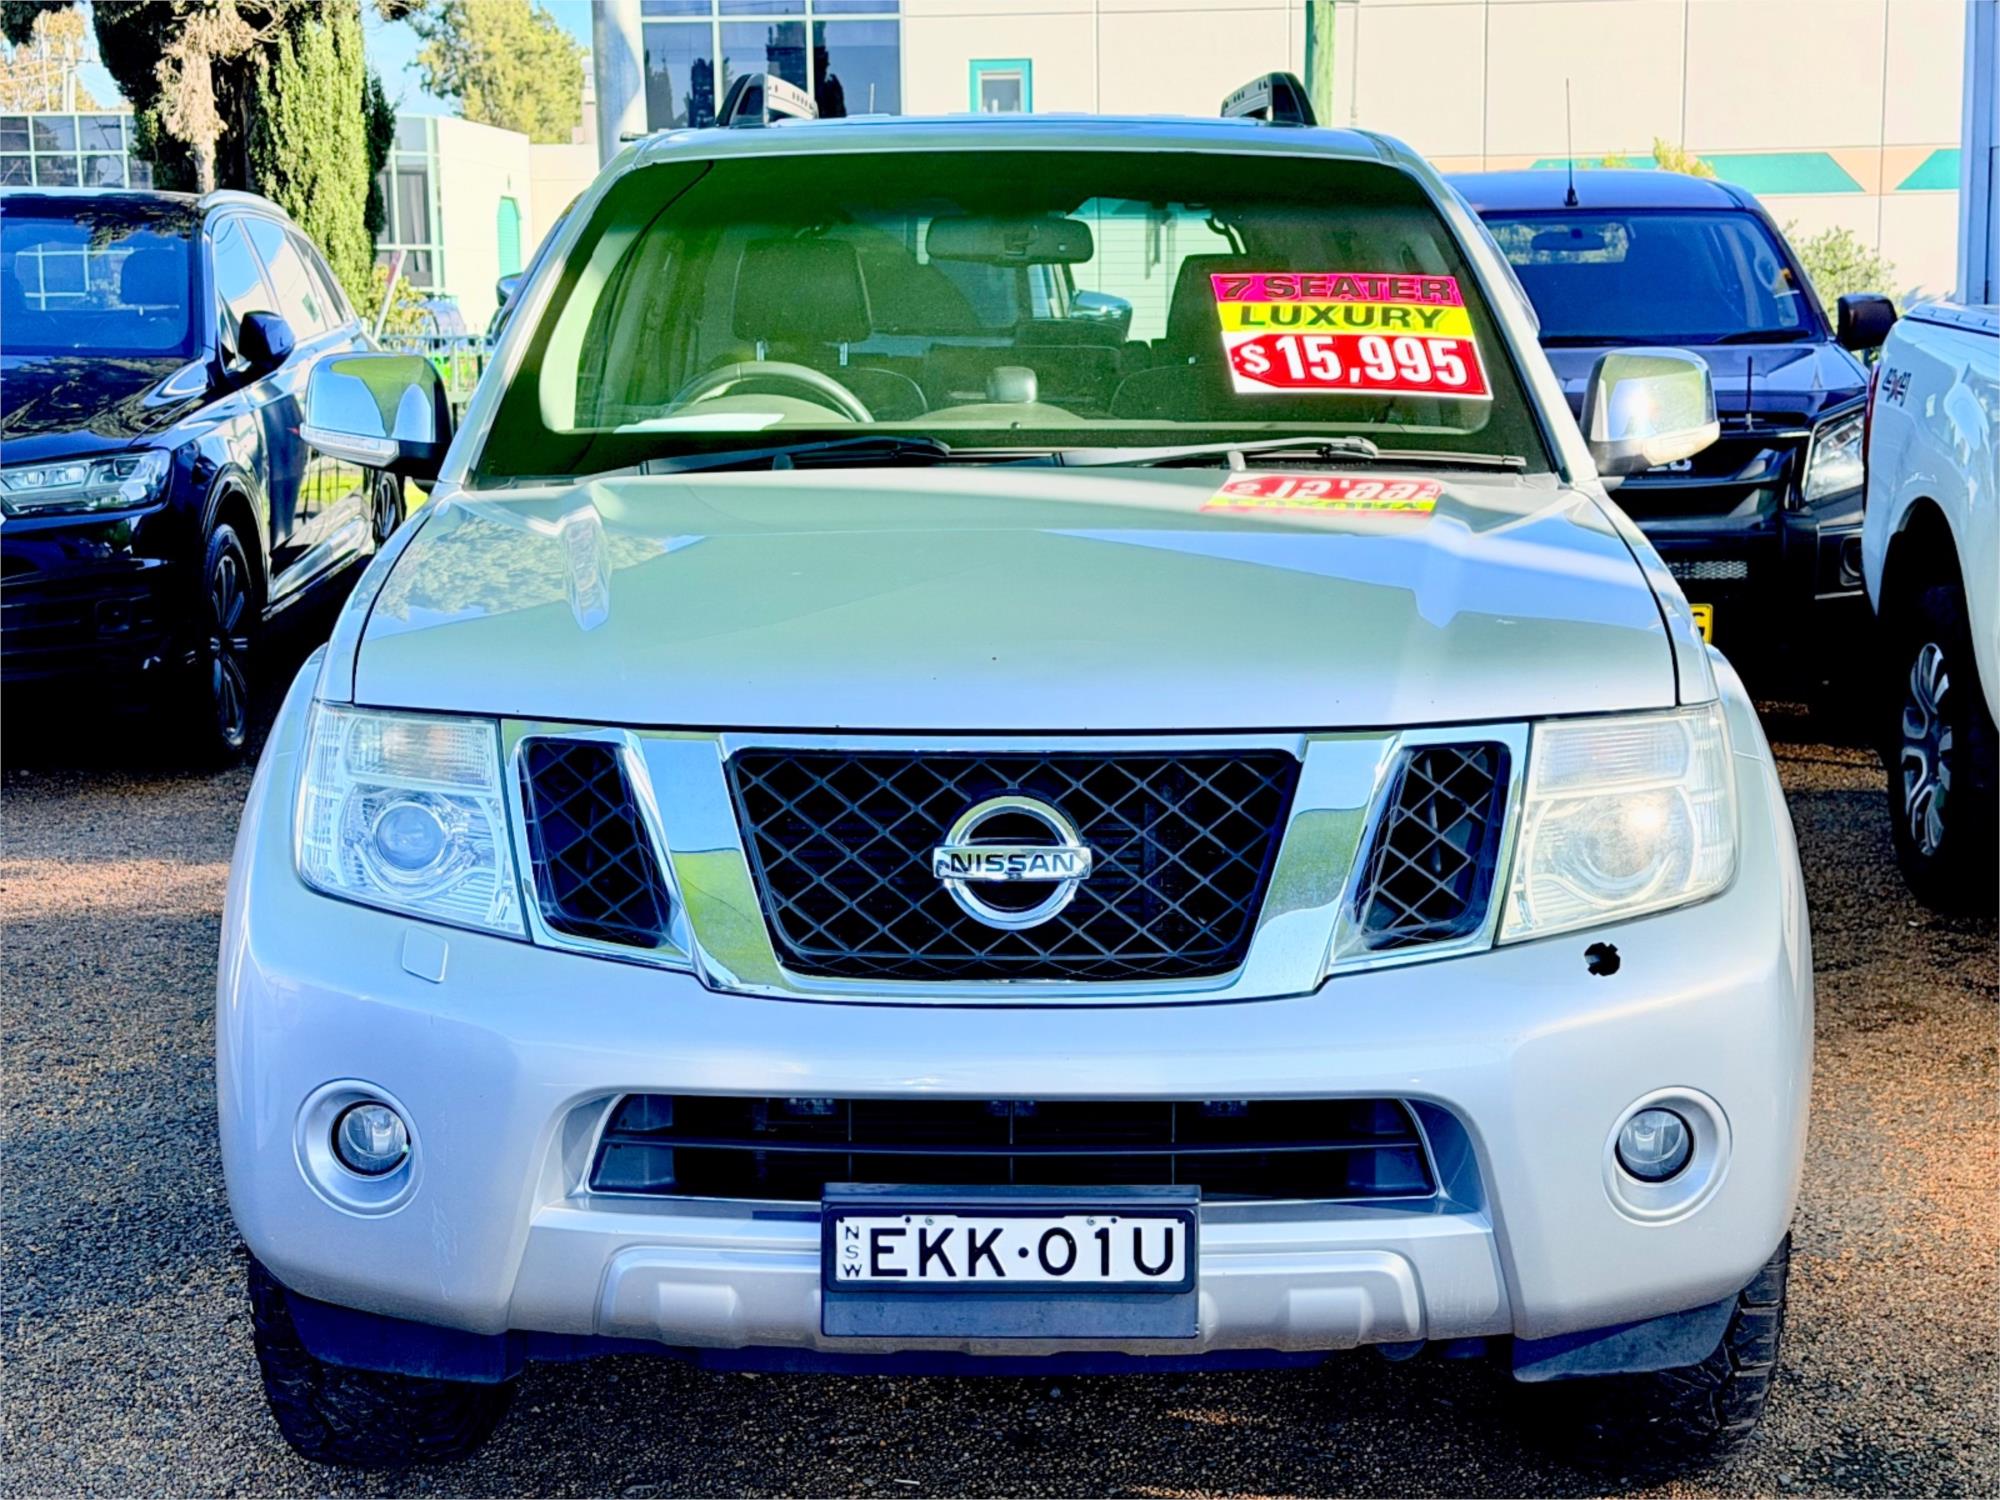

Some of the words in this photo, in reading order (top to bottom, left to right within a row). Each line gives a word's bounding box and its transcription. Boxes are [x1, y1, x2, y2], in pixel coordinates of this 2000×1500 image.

[1222, 276, 1252, 299] 7
[1264, 276, 1451, 301] SEATER
[1240, 304, 1445, 329] LUXURY
[950, 852, 1074, 873] NISSAN
